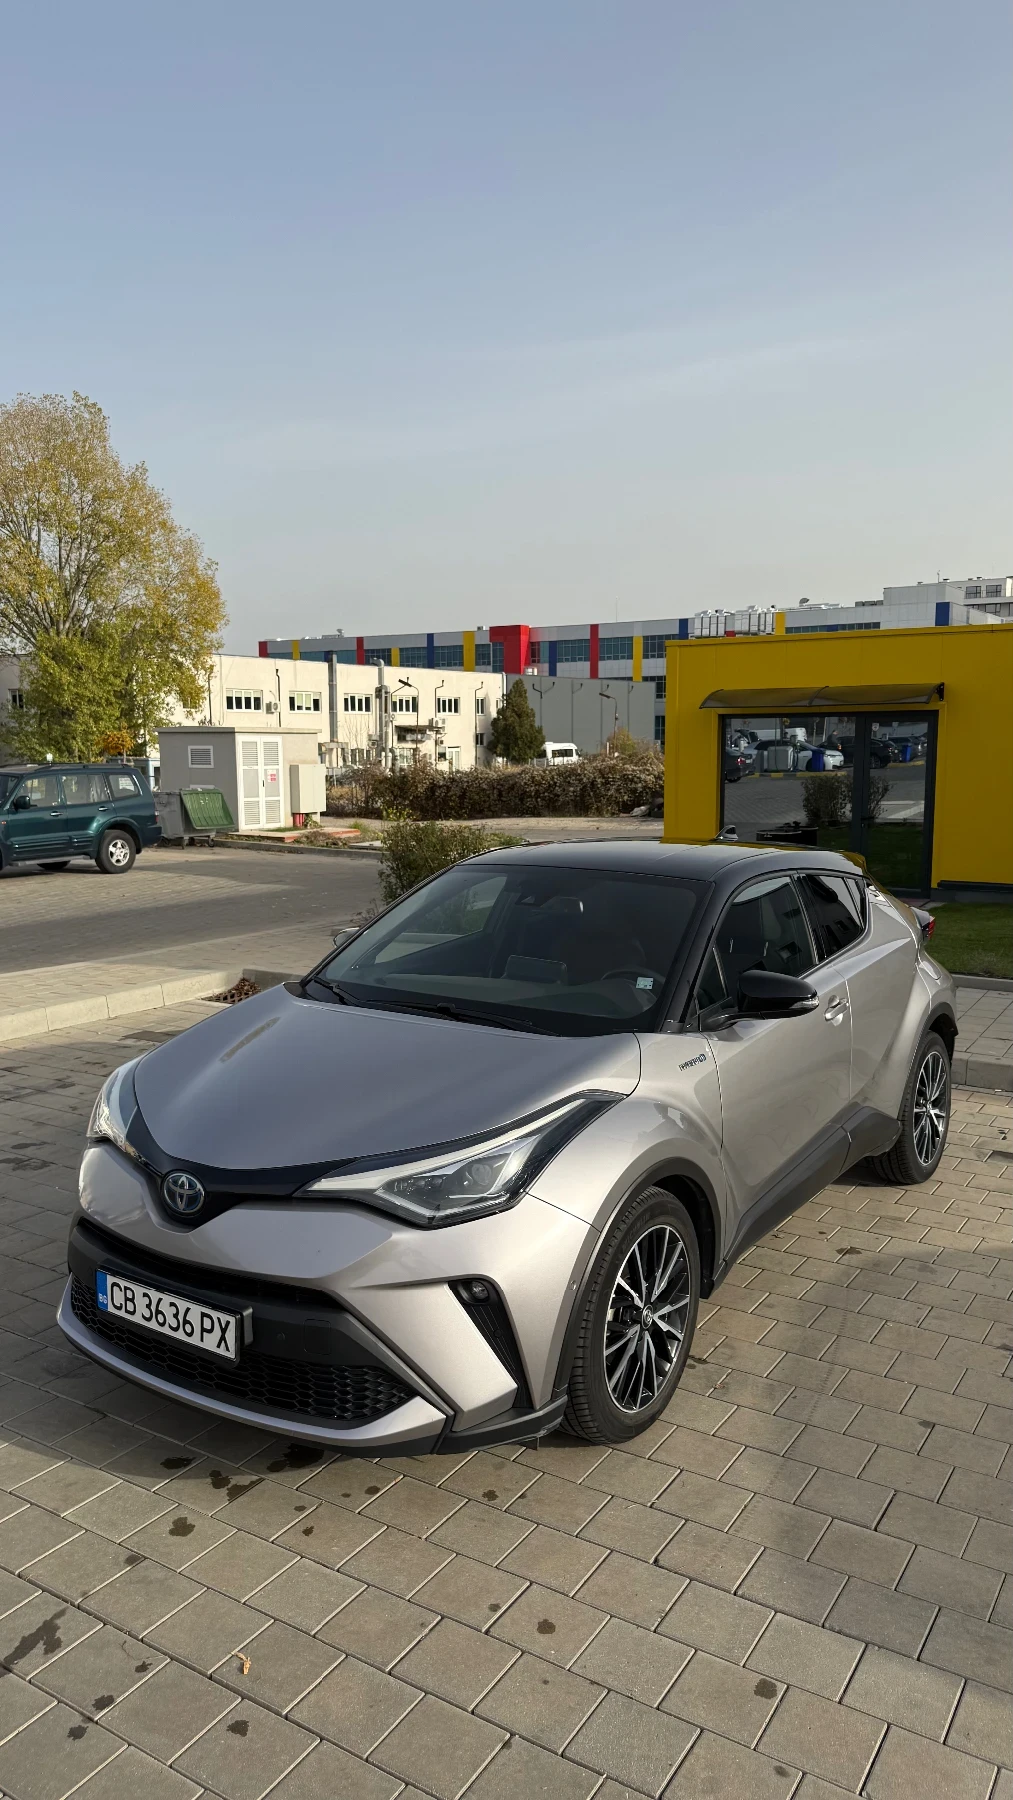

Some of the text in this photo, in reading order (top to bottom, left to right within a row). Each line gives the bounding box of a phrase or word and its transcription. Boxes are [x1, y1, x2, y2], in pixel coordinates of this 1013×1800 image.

[110, 1281, 231, 1353] CB 3636 PX
